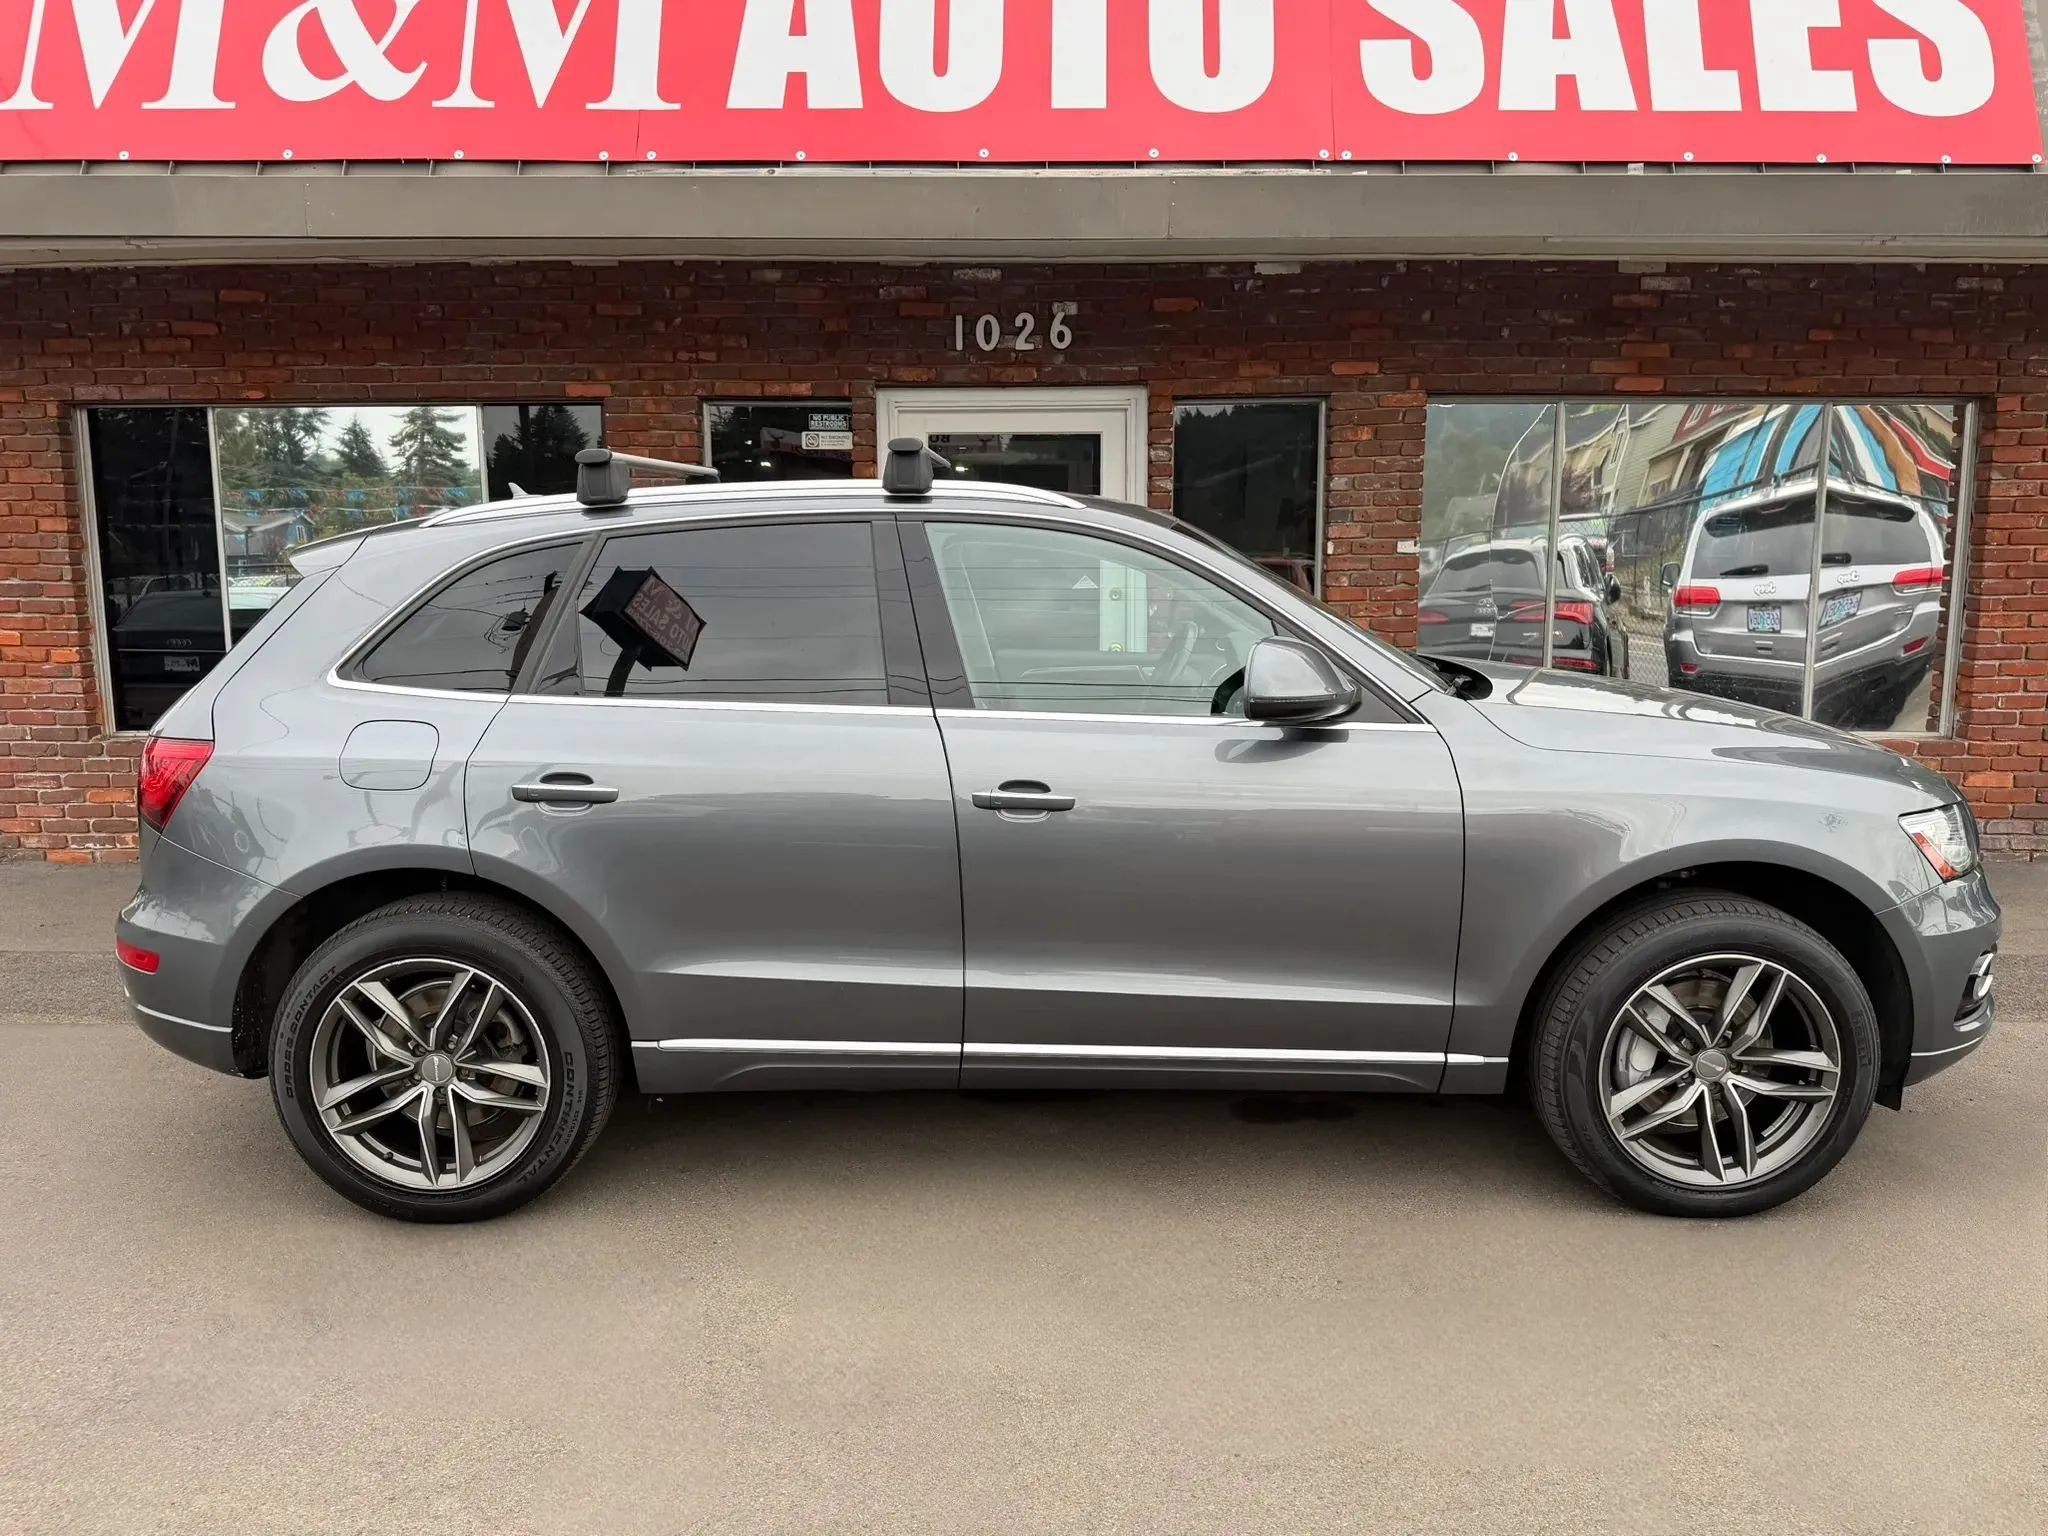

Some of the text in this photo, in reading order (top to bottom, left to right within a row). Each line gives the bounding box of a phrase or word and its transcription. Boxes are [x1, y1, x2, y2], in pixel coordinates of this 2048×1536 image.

[955, 311, 1072, 352] 1026
[290, 965, 337, 1032] CONTACT
[517, 1051, 575, 1184] CONTINENTAL
